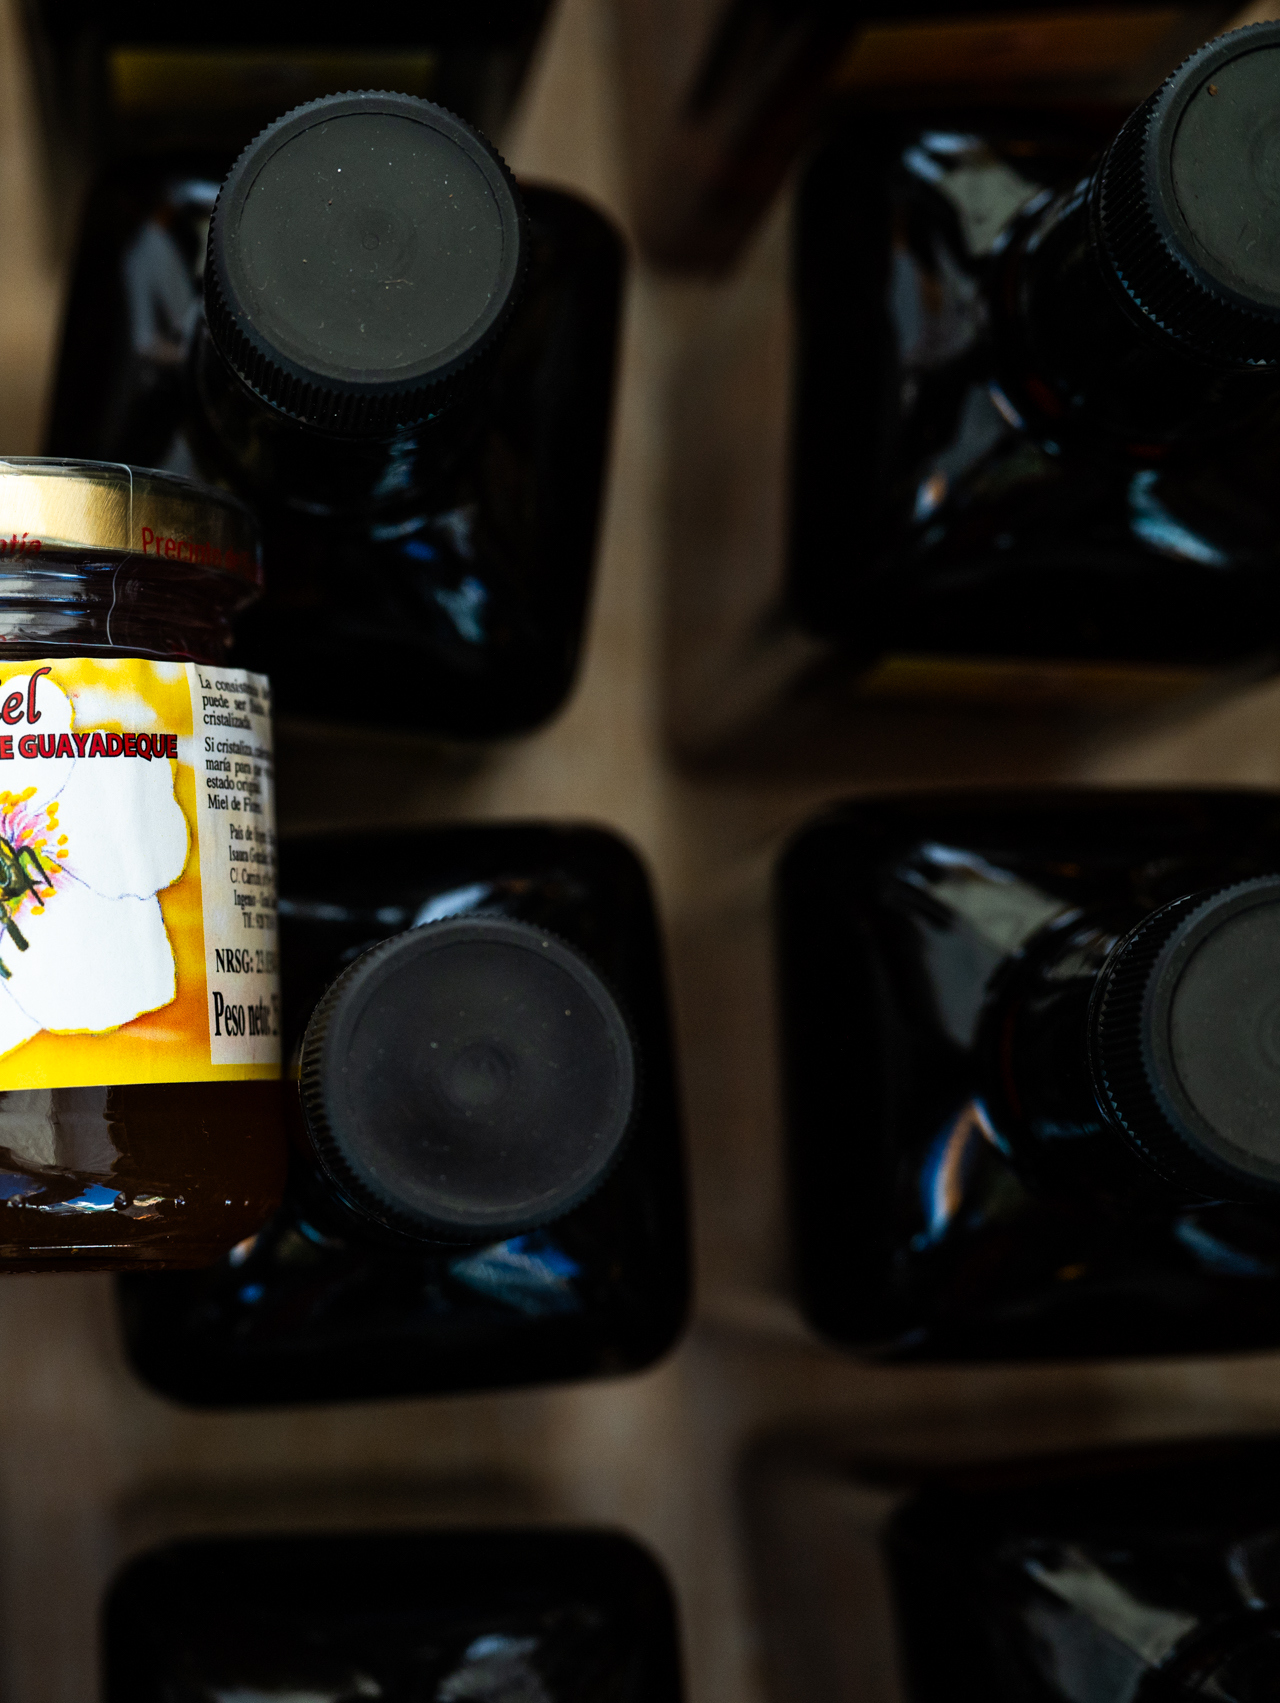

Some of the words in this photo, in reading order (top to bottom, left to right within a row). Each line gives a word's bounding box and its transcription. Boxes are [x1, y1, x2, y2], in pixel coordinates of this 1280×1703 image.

[198, 674, 212, 690] La
[202, 694, 230, 711] puede
[22, 732, 179, 762] GUAYADEQUE
[205, 736, 214, 752] Si
[206, 757, 231, 772] maría
[206, 775, 234, 791] estado
[207, 794, 229, 811] Miel
[231, 796, 241, 811] de
[215, 948, 254, 974] NRSG:
[212, 991, 245, 1036] Peso
